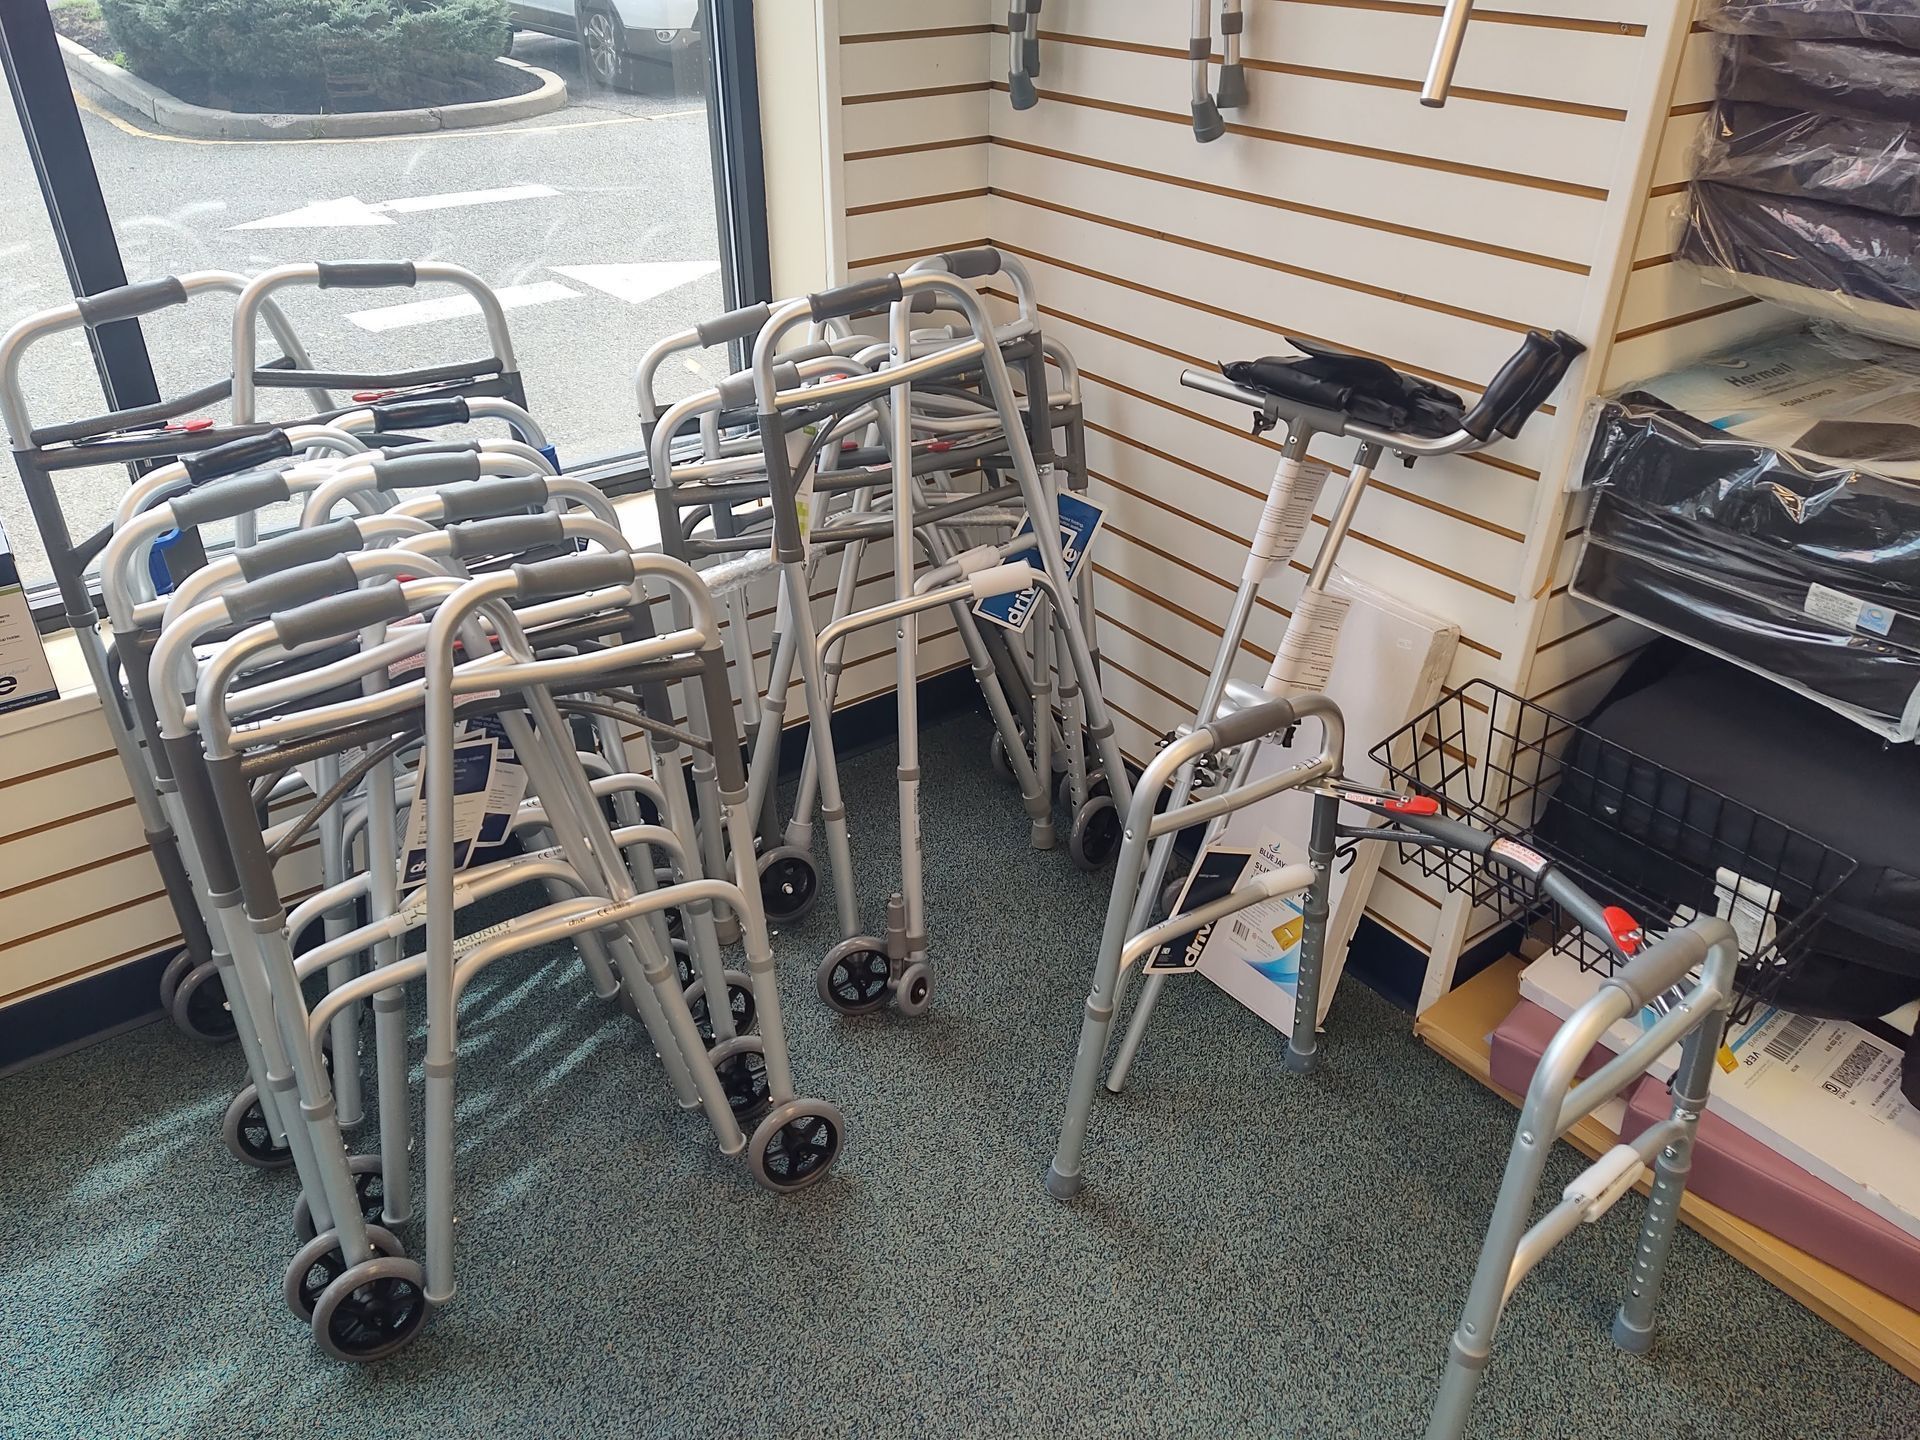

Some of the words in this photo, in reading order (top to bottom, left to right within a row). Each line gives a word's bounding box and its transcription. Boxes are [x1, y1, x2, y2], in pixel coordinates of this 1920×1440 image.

[1724, 361, 1795, 388] Hermell
[1008, 586, 1035, 624] driv
[1259, 847, 1276, 863] BLUE
[1274, 858, 1287, 869] JAY
[453, 920, 511, 948] MMUNITY
[1184, 920, 1215, 967] driv
